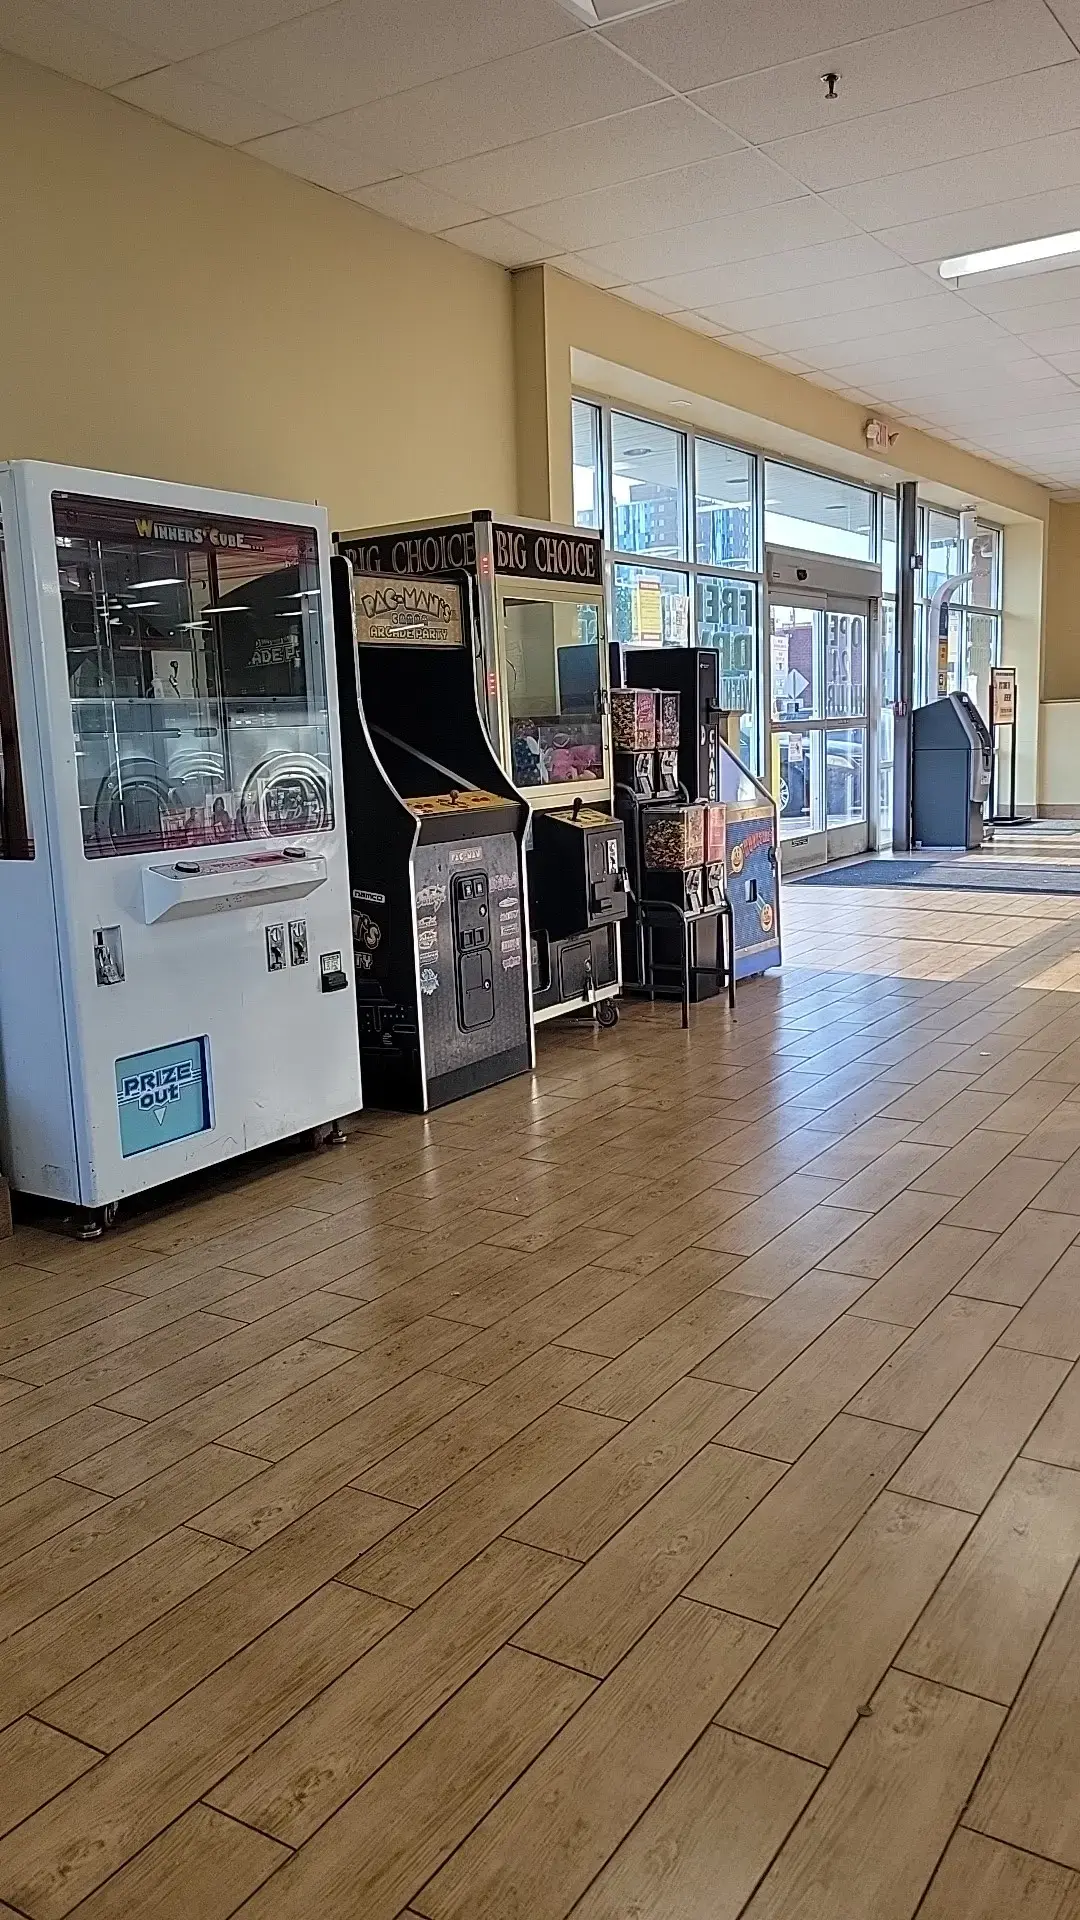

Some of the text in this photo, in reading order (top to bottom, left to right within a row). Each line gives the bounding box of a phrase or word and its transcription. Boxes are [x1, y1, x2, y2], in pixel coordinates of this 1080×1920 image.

[391, 532, 475, 575] CHOICE
[496, 530, 596, 578] BIG CHOICE
[361, 586, 452, 624] PAC-MAN'S
[370, 625, 448, 641] ARCADE PARTY
[708, 729, 716, 801] CHANG
[354, 890, 384, 902] namco
[124, 1062, 192, 1098] PRIZE
